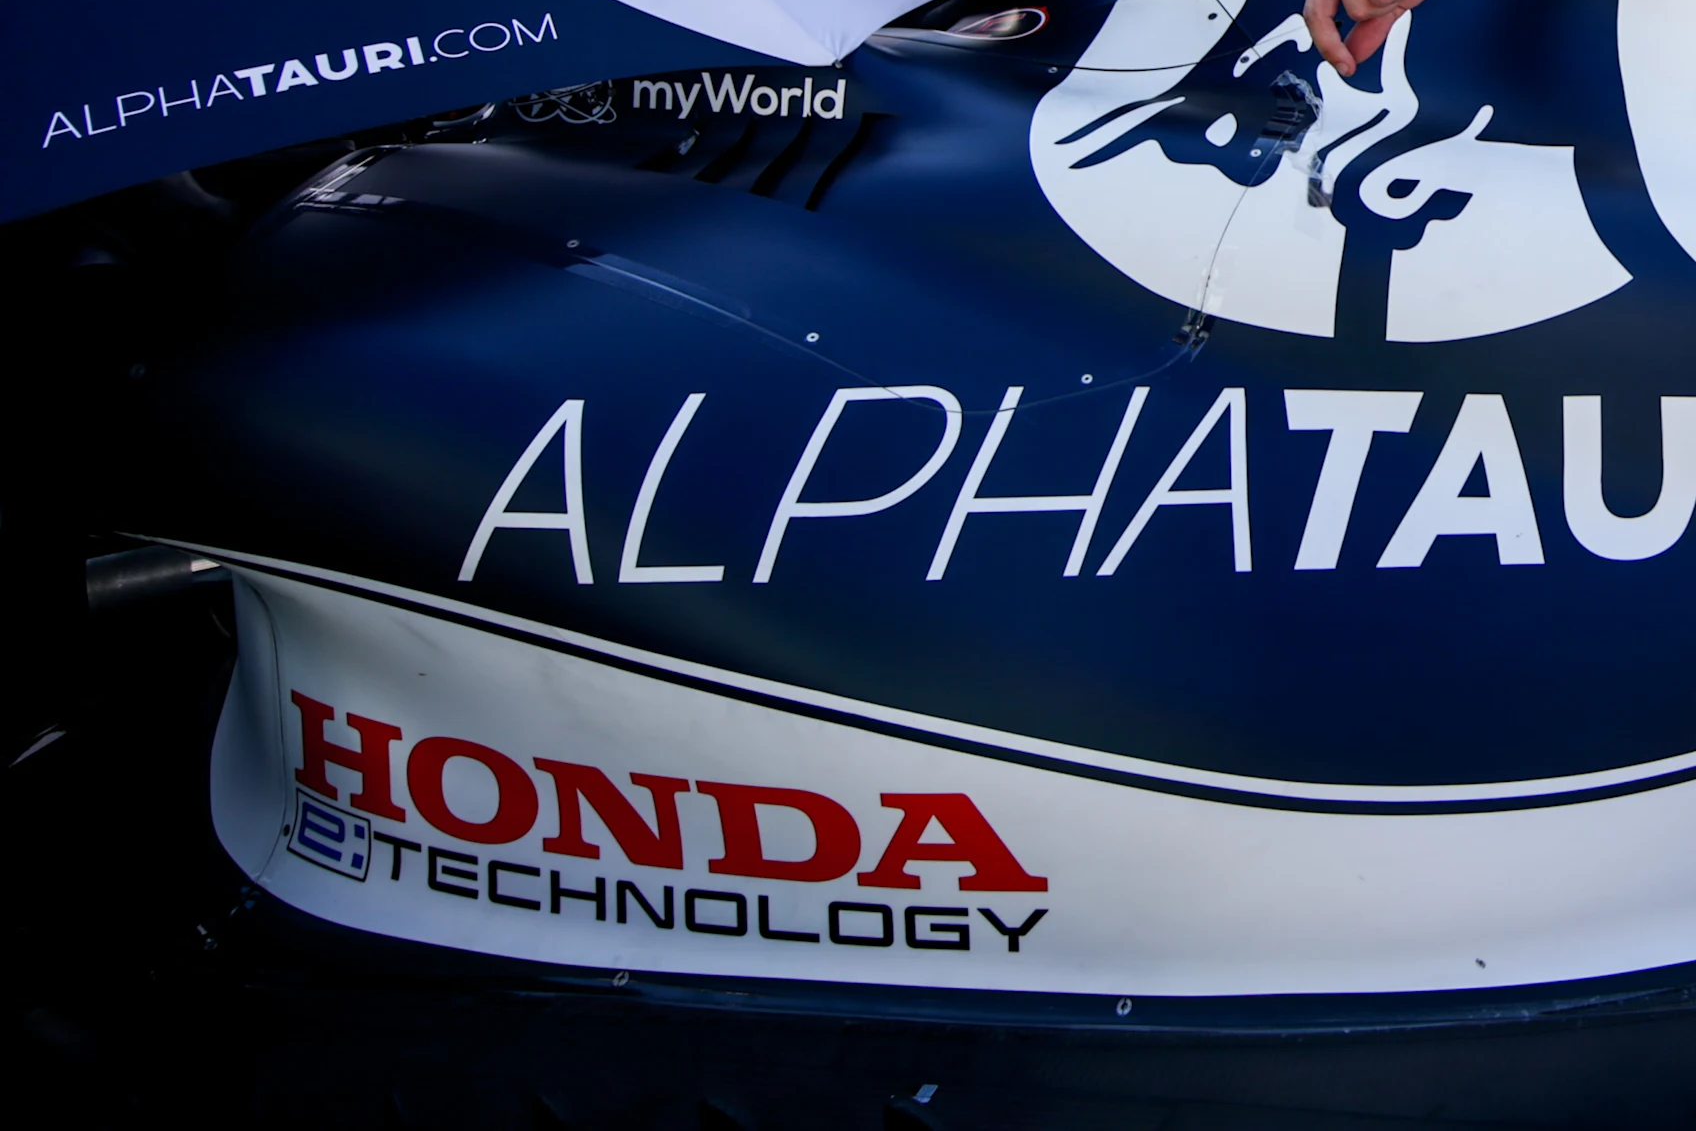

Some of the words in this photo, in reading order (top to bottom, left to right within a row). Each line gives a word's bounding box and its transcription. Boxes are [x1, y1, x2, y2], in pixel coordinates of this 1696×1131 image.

[42, 13, 559, 148] ALPHATAURI.COM
[633, 72, 847, 120] myWorld
[290, 689, 1049, 893] HONDA
